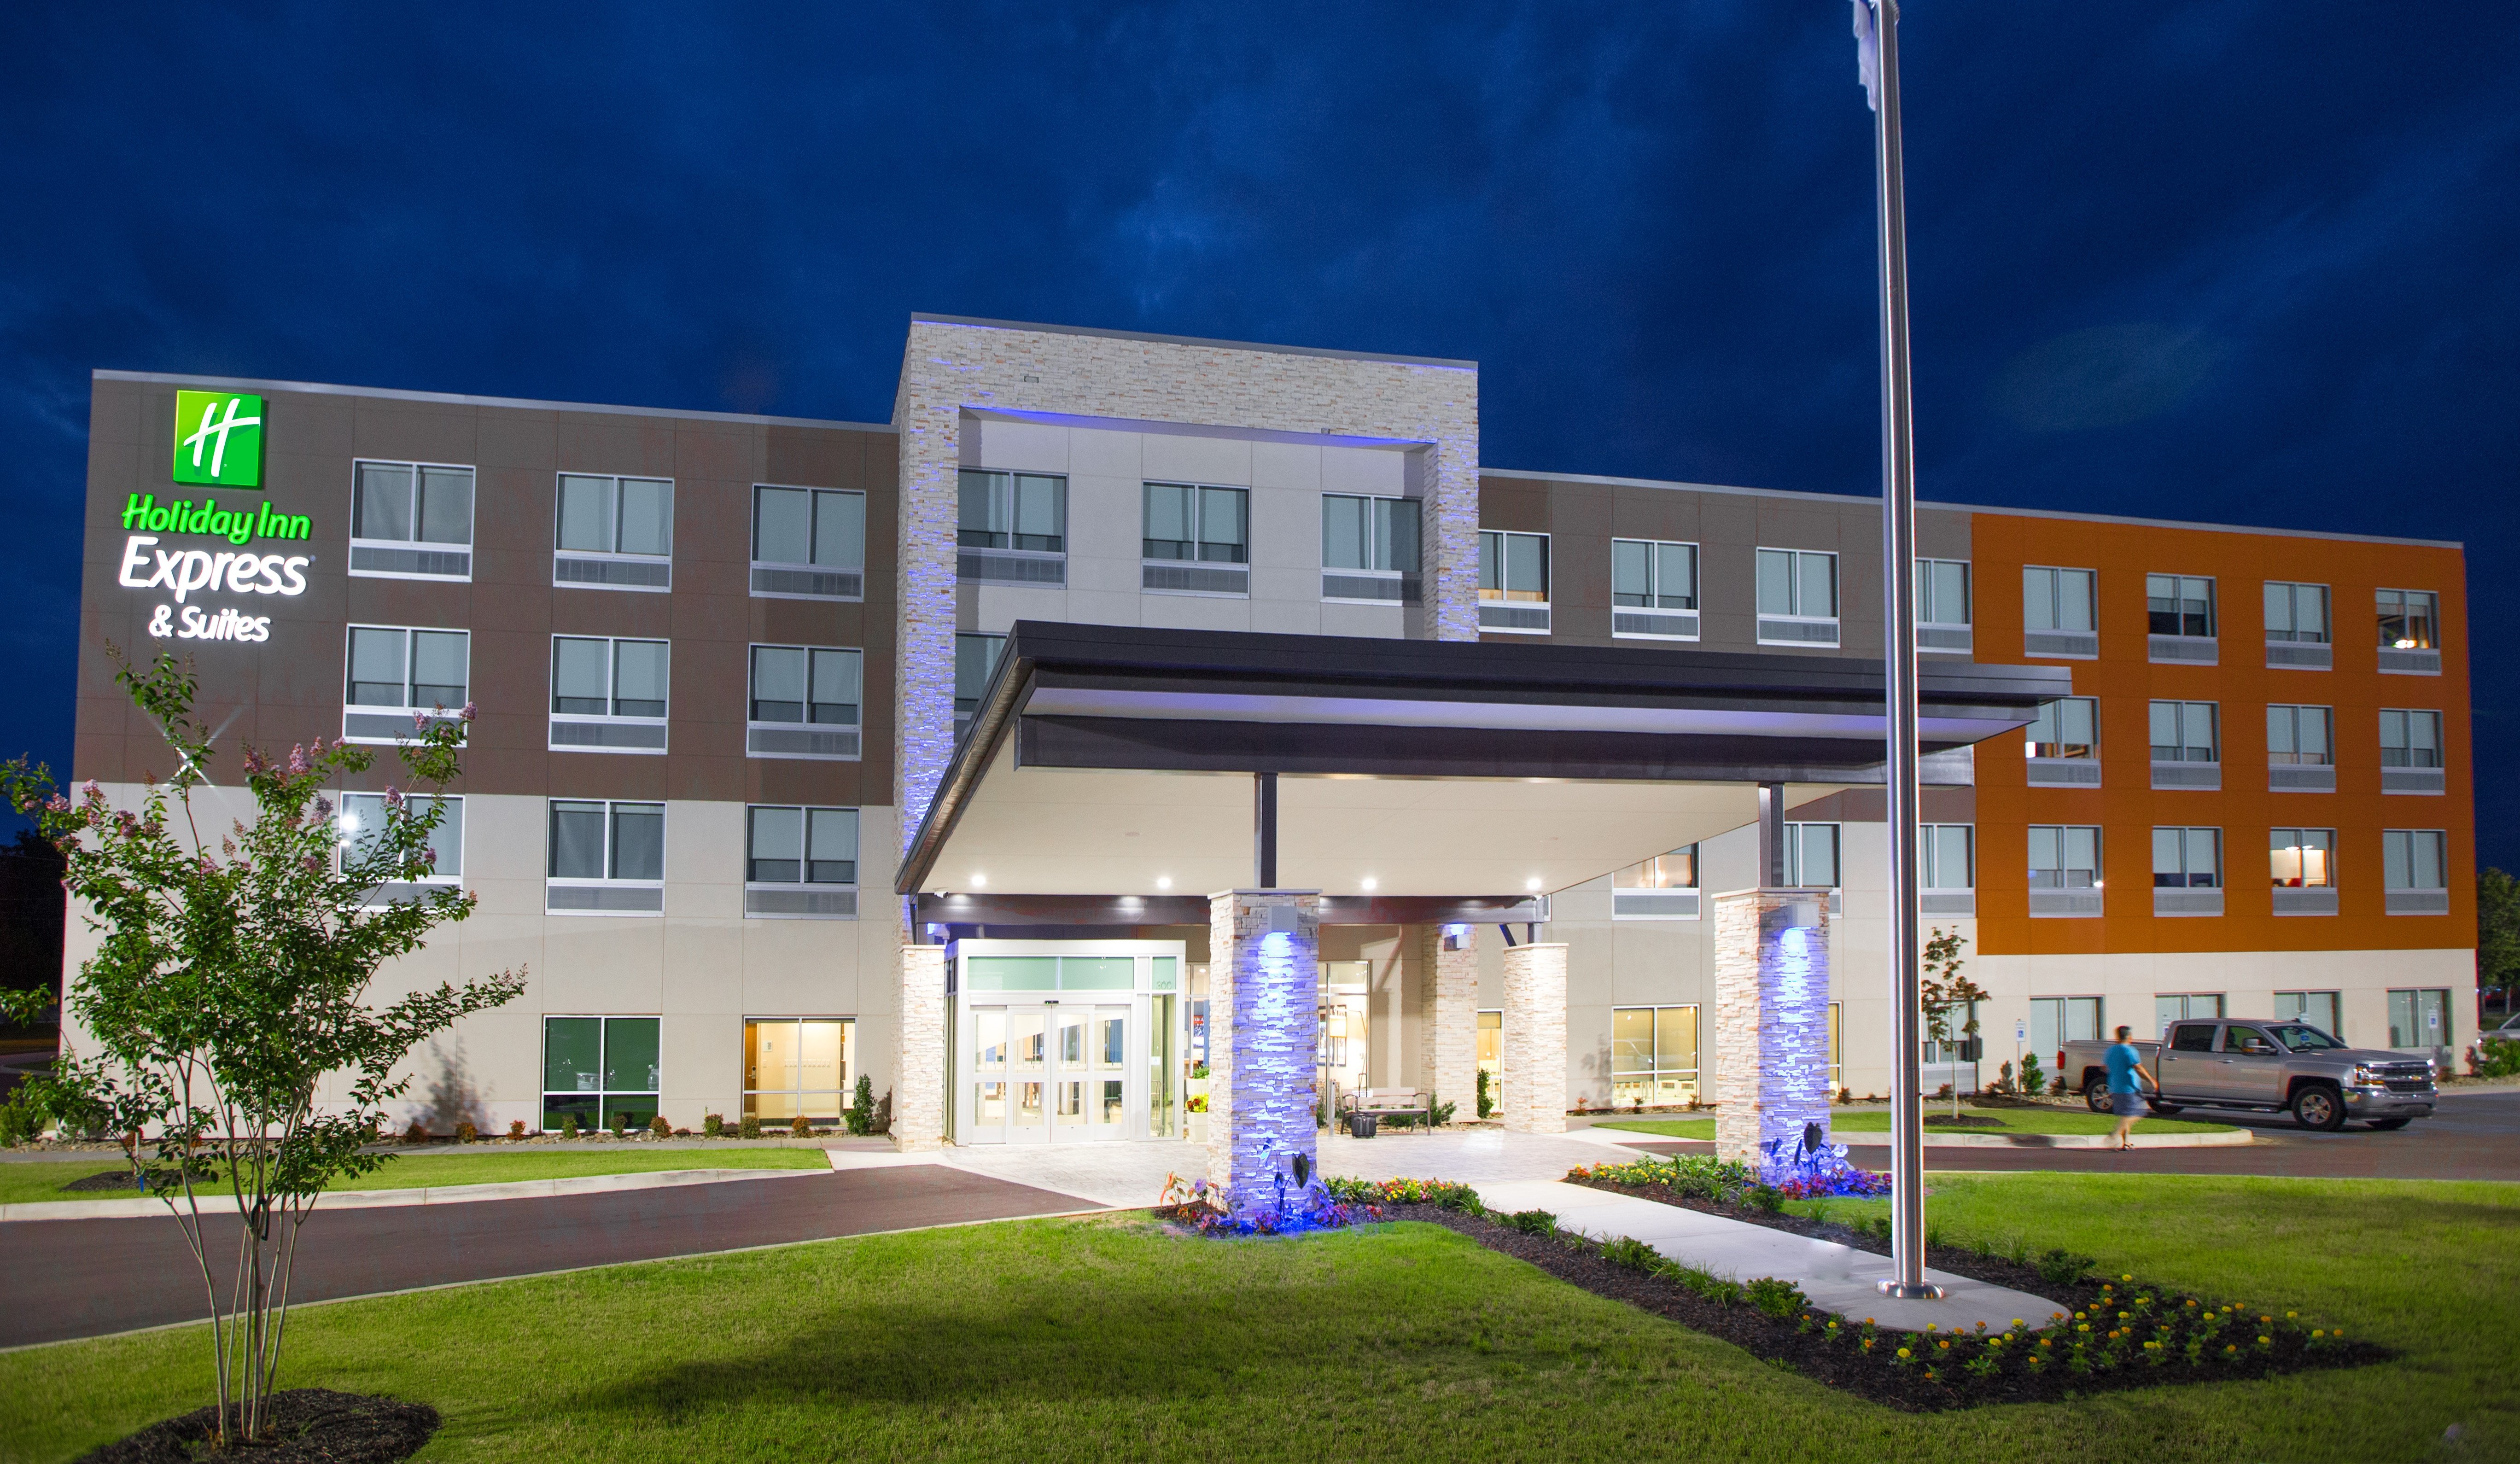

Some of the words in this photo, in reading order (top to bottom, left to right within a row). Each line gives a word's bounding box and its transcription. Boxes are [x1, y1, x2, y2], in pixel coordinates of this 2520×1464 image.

[122, 493, 255, 545] Holiday
[257, 501, 311, 540] Inn
[119, 536, 309, 603] Express
[149, 604, 173, 637] &
[177, 606, 271, 642] Suites
